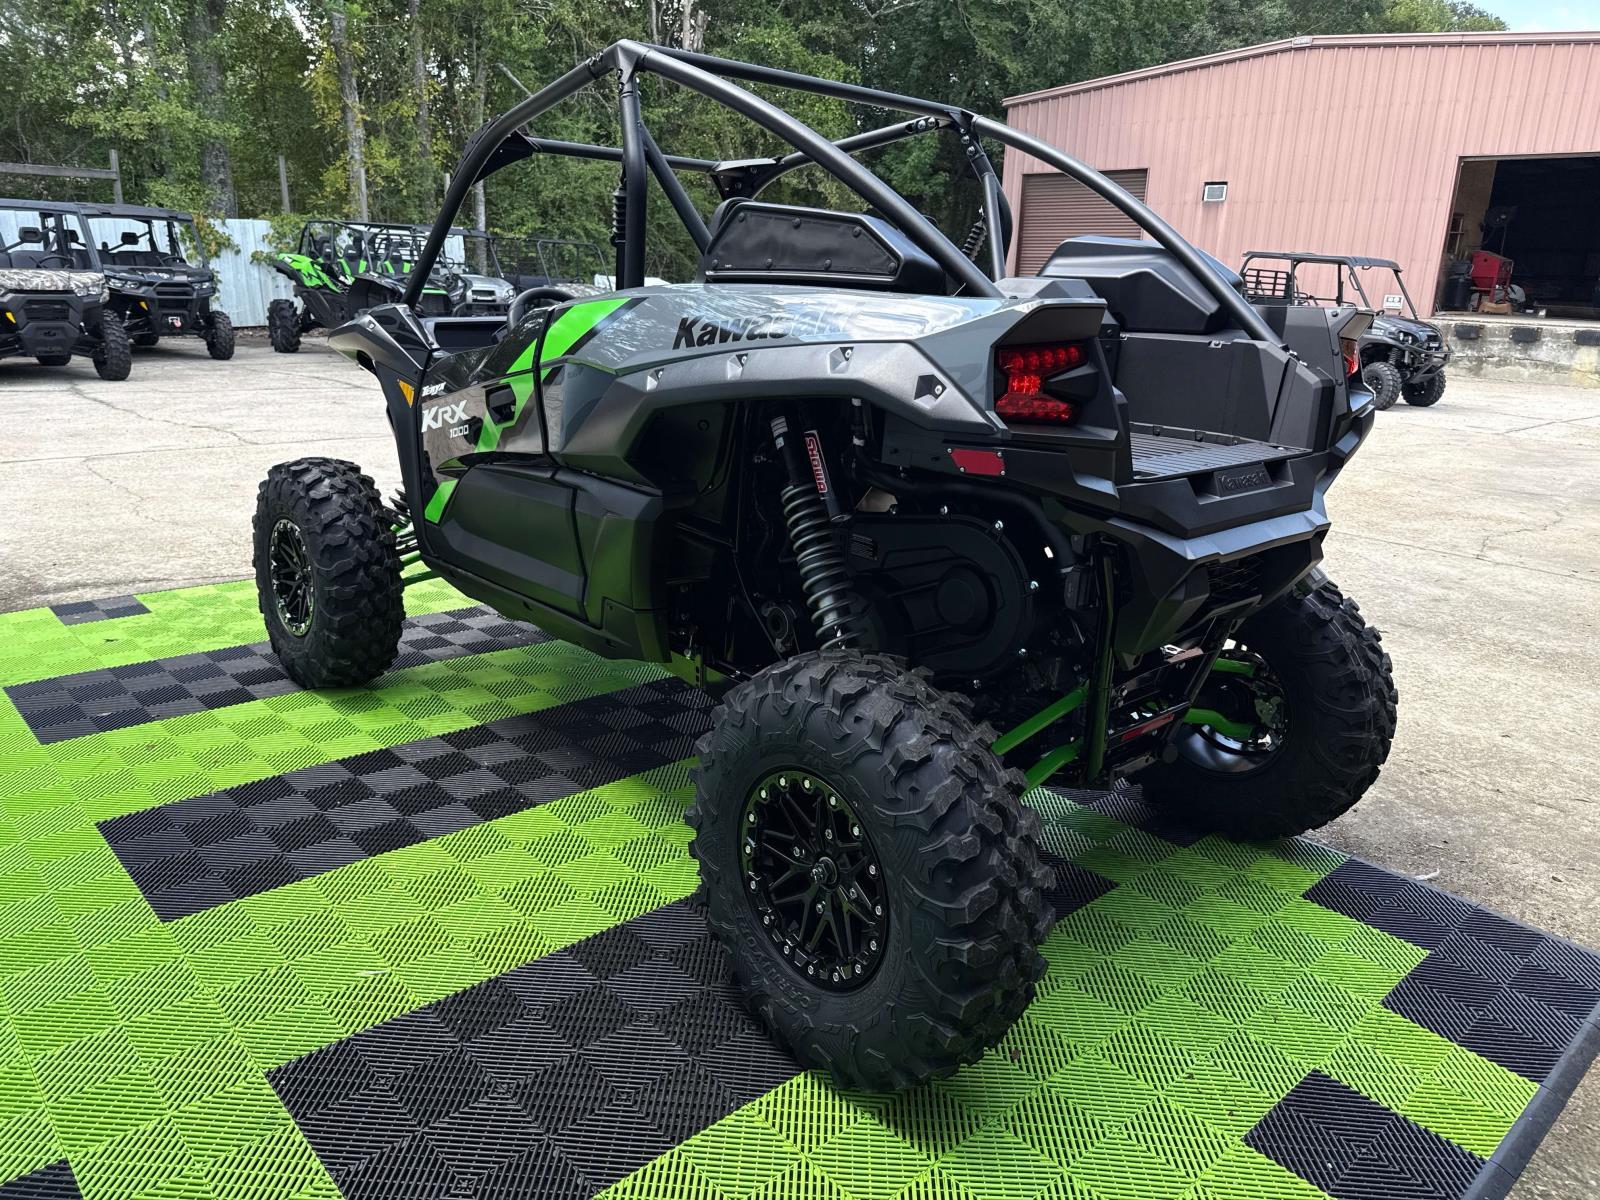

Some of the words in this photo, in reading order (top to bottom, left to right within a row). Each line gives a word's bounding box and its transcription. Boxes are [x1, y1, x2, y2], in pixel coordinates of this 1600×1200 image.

[421, 400, 470, 433] KRX
[449, 425, 469, 438] 1000
[805, 437, 827, 493] SHOWA
